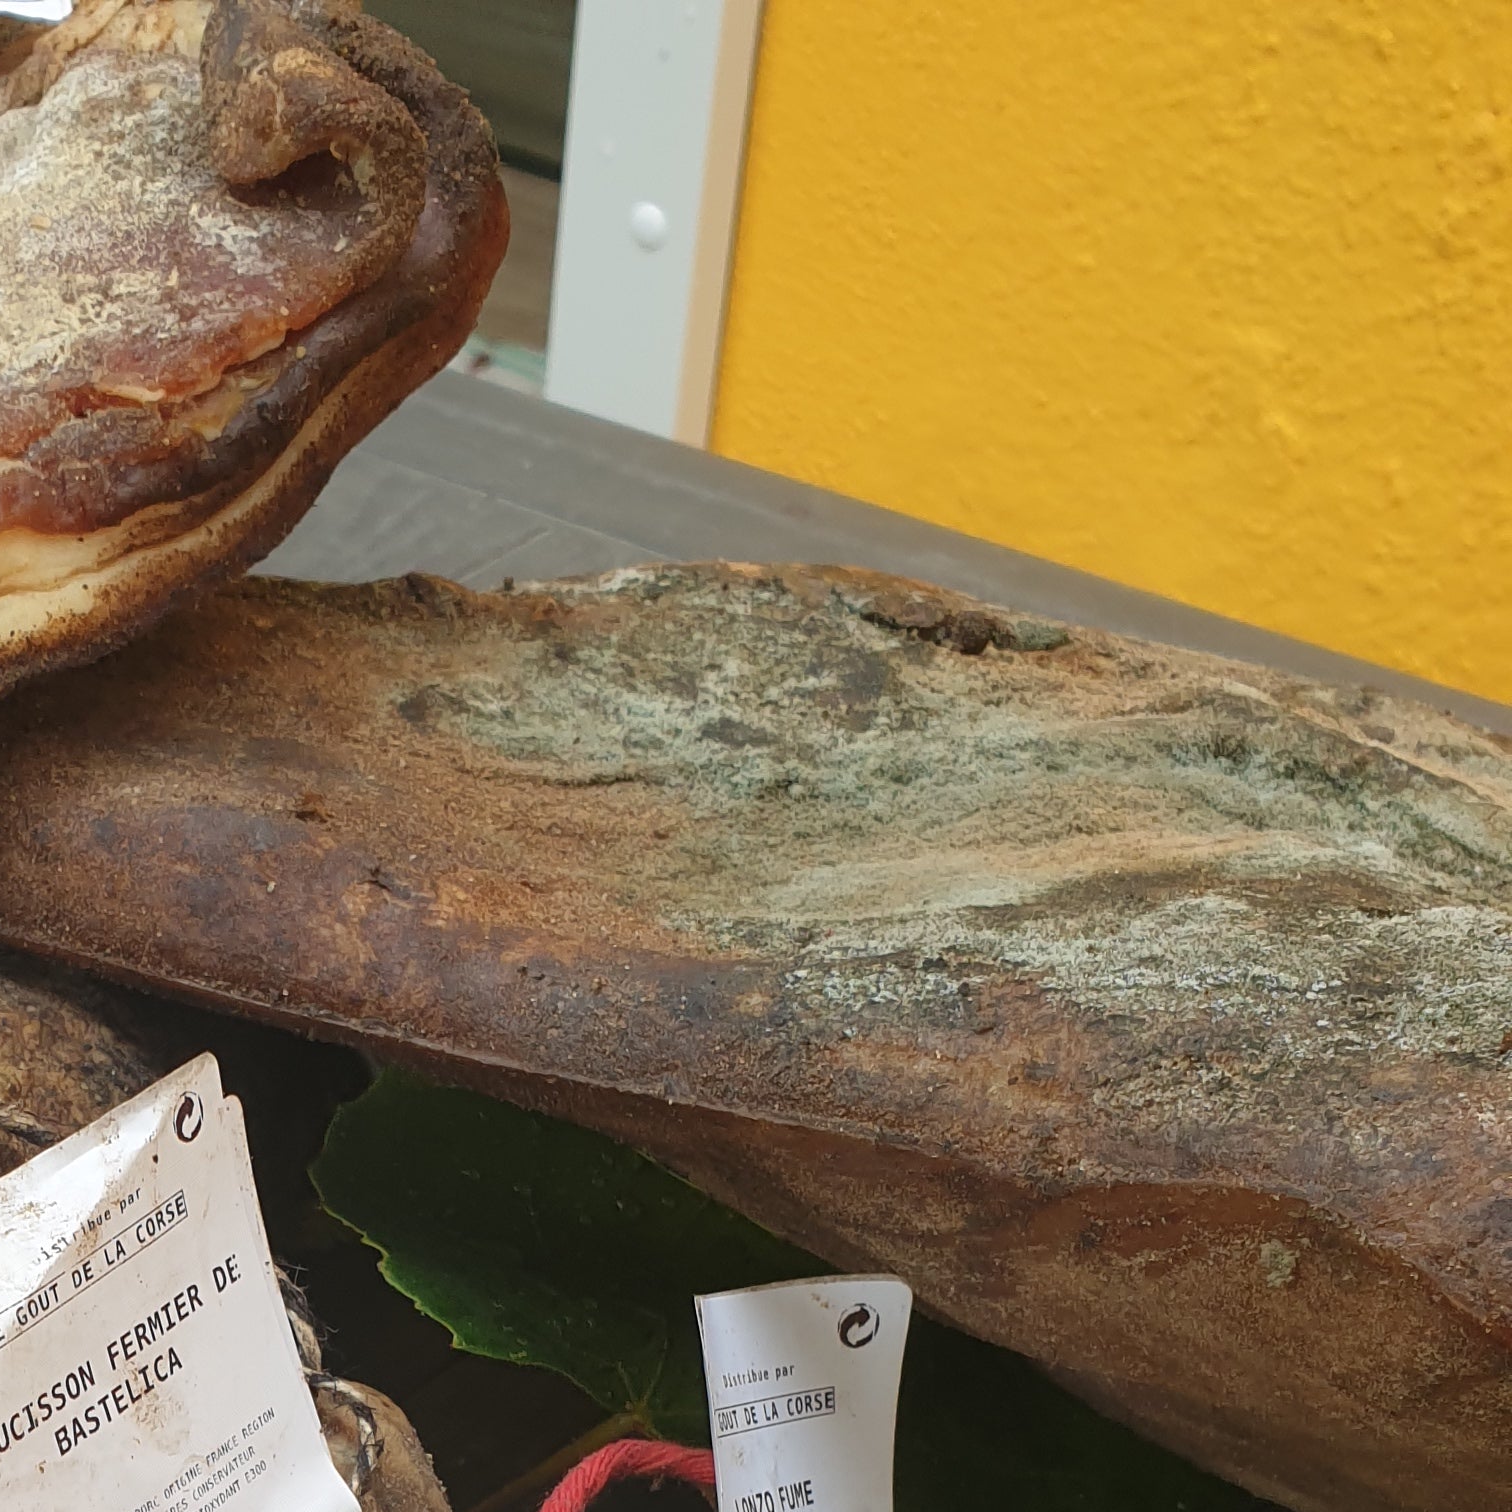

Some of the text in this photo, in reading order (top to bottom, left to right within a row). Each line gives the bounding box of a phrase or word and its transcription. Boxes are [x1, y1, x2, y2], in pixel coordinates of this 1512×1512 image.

[33, 1187, 142, 1266] istribue par
[15, 1283, 60, 1326] GOUT
[71, 1261, 95, 1289] DE
[103, 1239, 127, 1266] LA
[135, 1196, 187, 1244] CORSE
[106, 1283, 204, 1371] FERMIER
[212, 1254, 241, 1293] DE
[54, 1347, 183, 1456] BASTELICA
[723, 1364, 795, 1388] Distribue par
[205, 1435, 239, 1467] FRANCE
[241, 1407, 276, 1440] REGION
[717, 1391, 834, 1432] GOUT DE LA CORSE
[192, 1445, 256, 1502] CONSERVATEUR
[245, 1460, 267, 1484] E300
[778, 1480, 814, 1512] FUME
